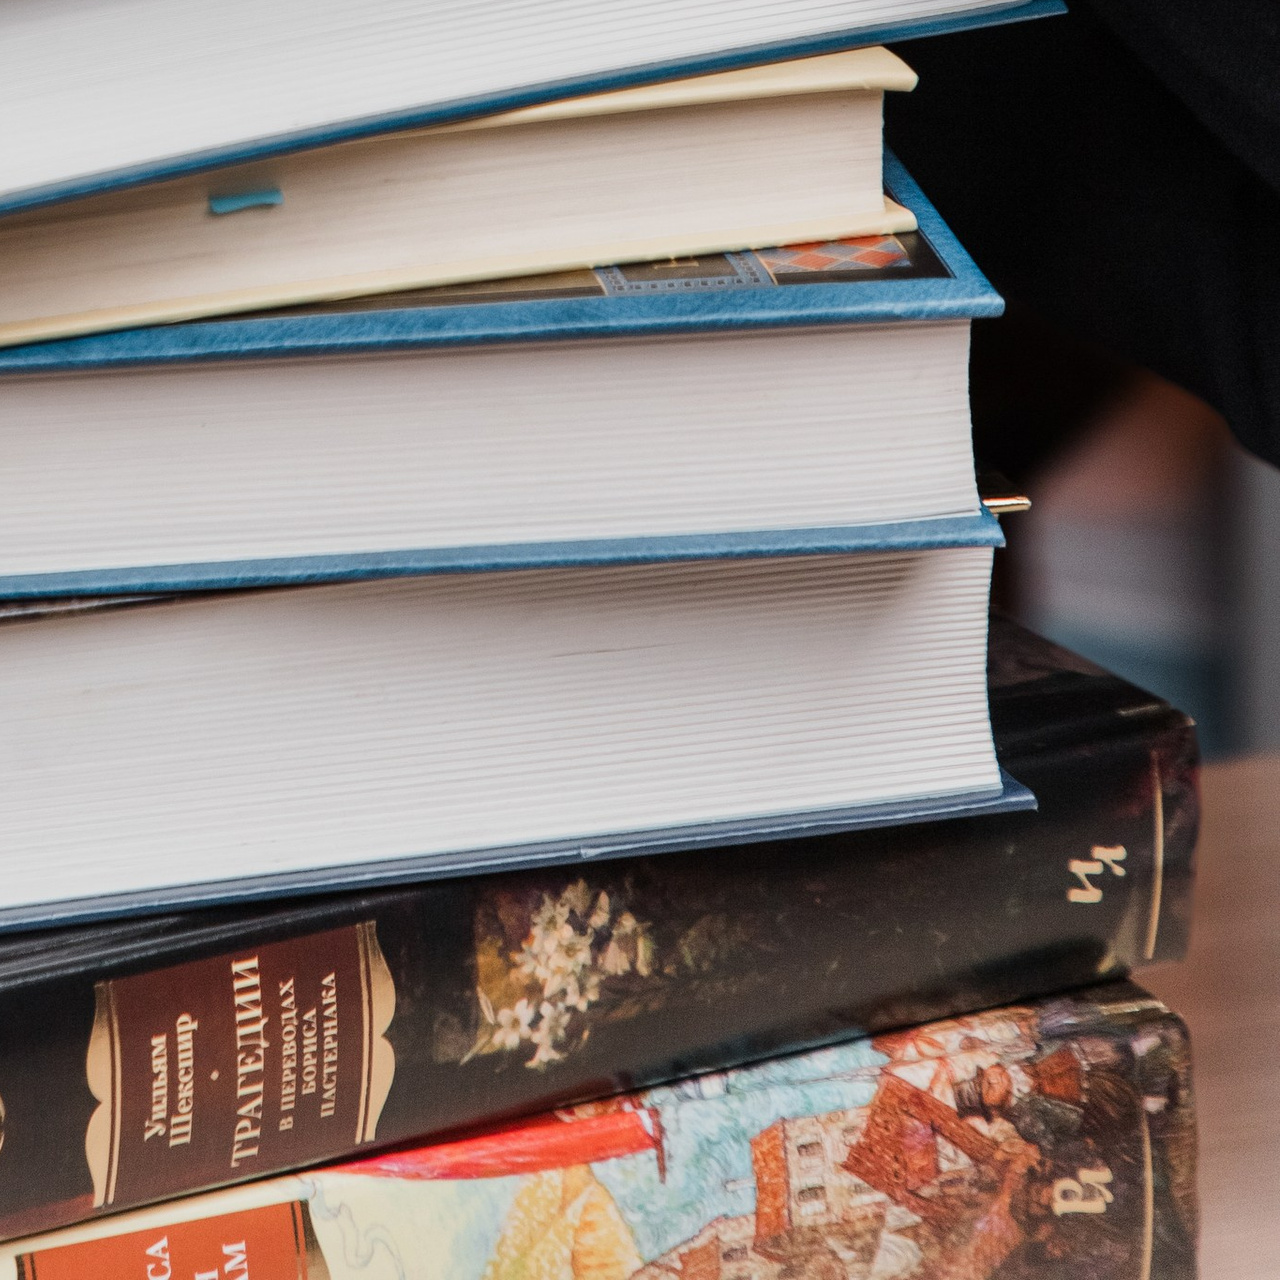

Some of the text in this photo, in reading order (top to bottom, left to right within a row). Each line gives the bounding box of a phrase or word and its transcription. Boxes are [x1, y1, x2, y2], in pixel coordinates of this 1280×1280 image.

[144, 1033, 167, 1142] Уильям
[169, 1012, 198, 1148] Шекспир
[231, 955, 269, 1168] ТРАГЕДИИ
[279, 977, 300, 1131] В ПЕРЕВОДАХ
[302, 1008, 318, 1095] БОРИСА
[320, 972, 339, 1118] ПАСТЕРНАКА
